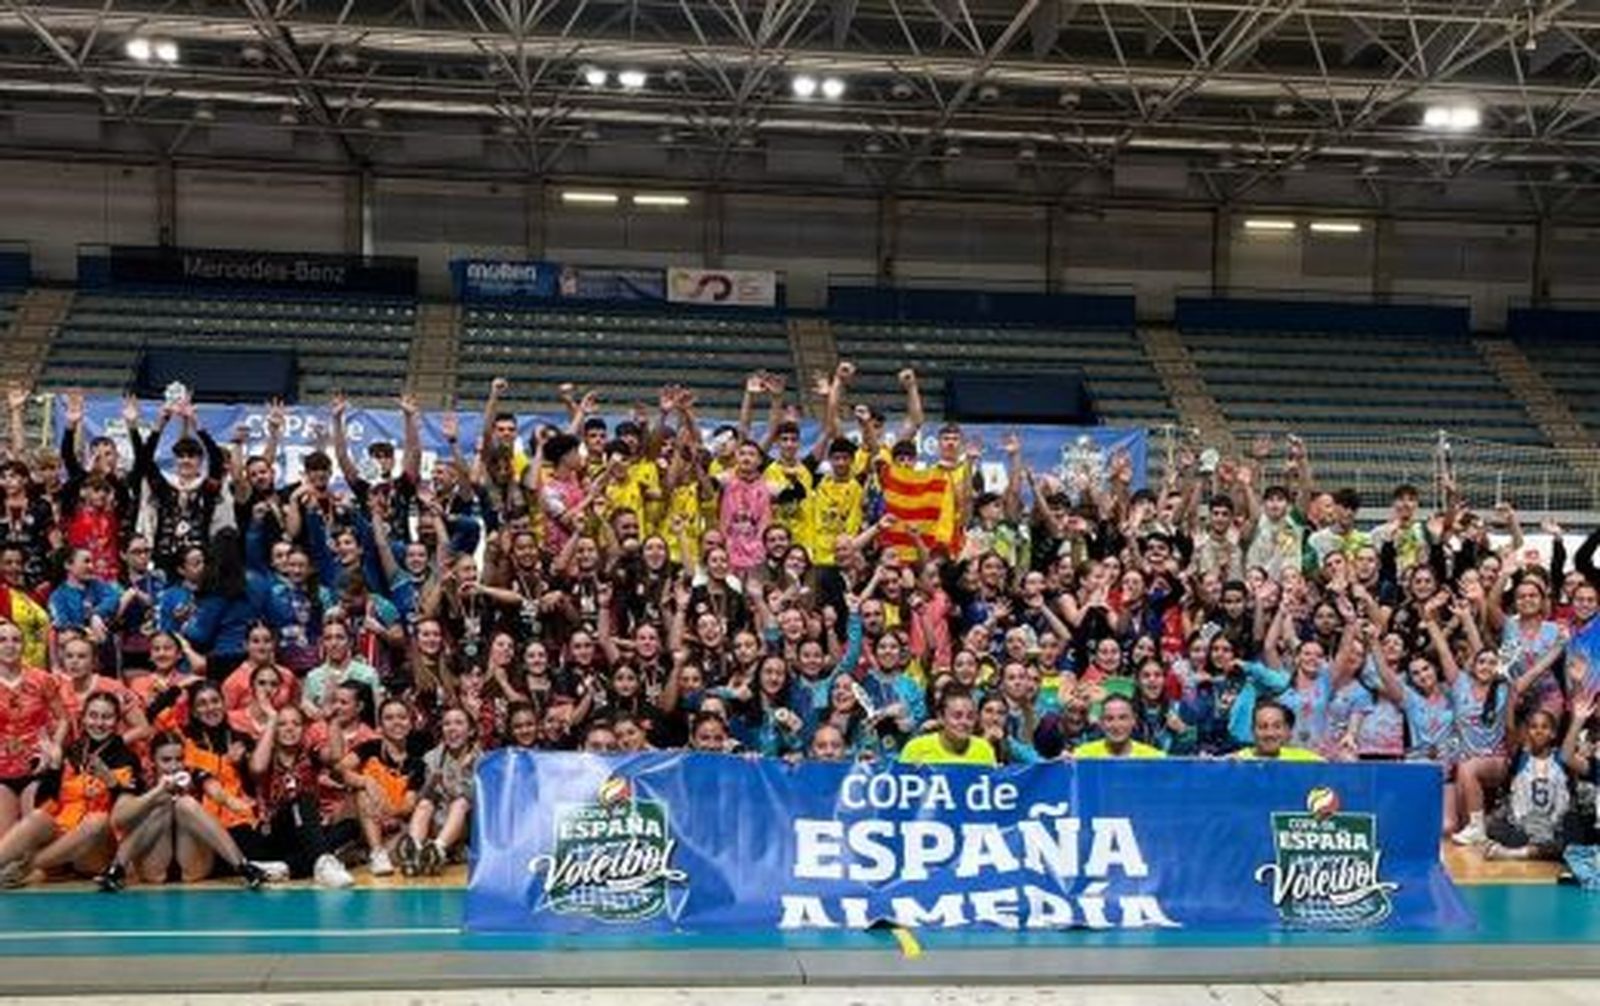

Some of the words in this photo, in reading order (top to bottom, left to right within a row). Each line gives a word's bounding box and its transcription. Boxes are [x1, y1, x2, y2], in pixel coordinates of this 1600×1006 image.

[183, 255, 345, 284] Mercedes-Benz
[840, 774, 957, 810] COPA
[966, 779, 1019, 812] de
[559, 813, 662, 840] ESPAÑA
[792, 801, 1150, 883] ESPAÑA
[1279, 827, 1370, 851] ESPAÑA
[528, 838, 688, 892] Voleibol
[1254, 849, 1400, 906] Voleibol
